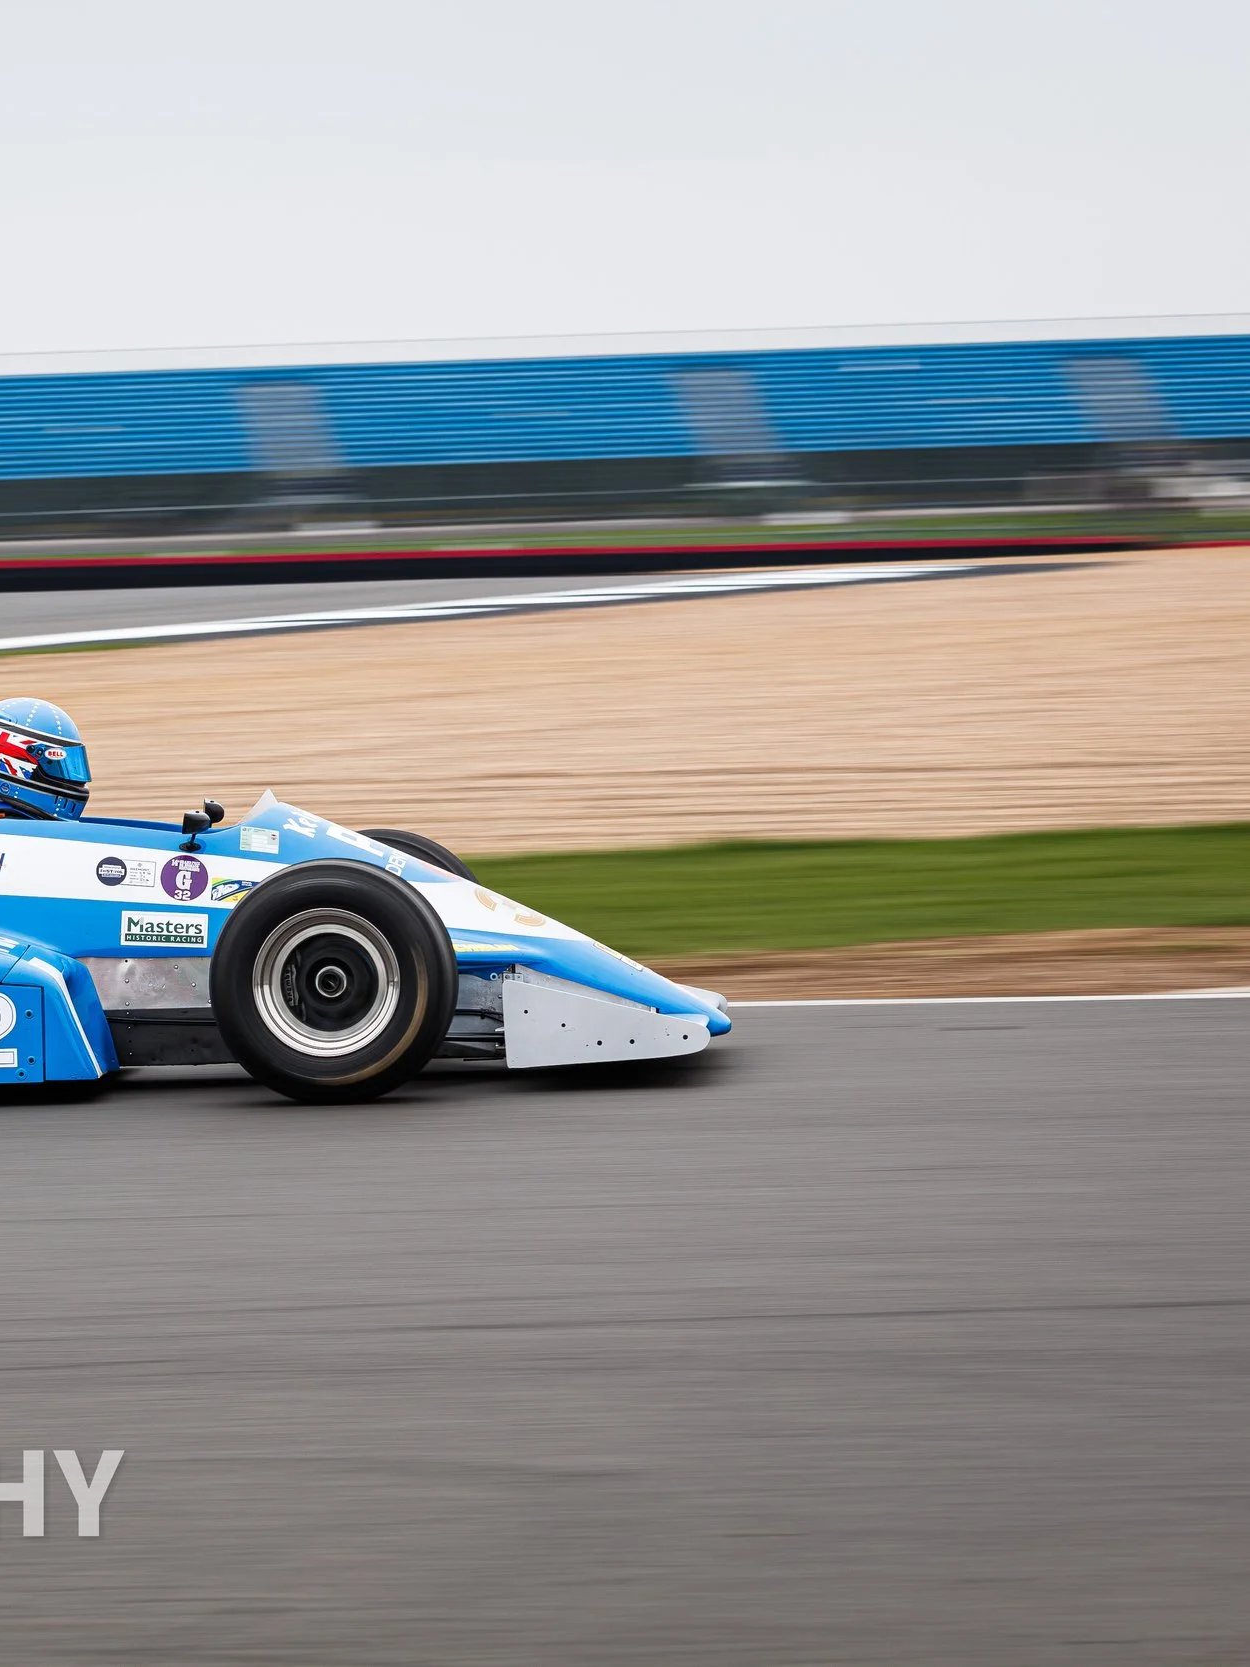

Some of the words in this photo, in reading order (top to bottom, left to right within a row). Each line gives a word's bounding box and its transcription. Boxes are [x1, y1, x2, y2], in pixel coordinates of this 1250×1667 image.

[176, 870, 192, 890] G
[174, 890, 191, 900] 32
[127, 917, 203, 934] Masters
